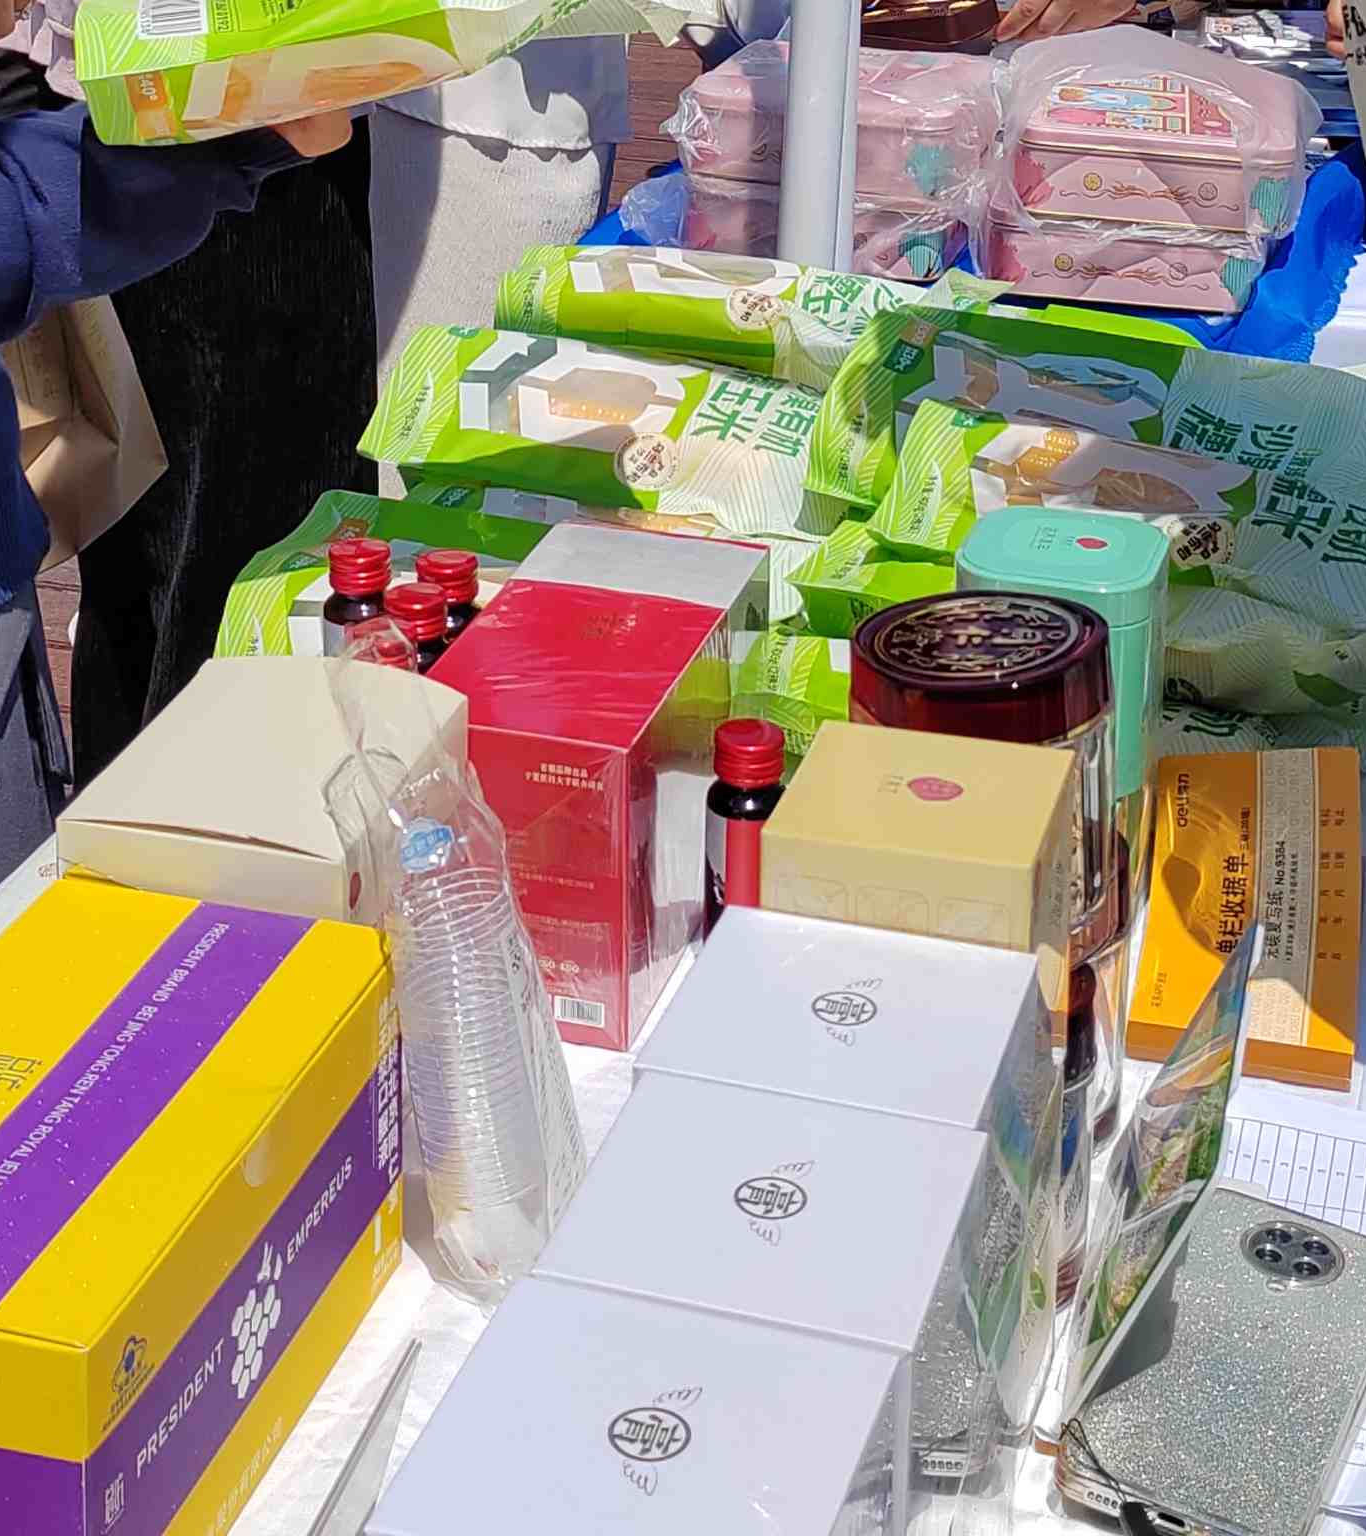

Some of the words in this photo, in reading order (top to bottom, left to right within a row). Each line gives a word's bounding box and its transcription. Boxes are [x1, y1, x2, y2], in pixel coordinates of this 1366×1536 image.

[181, 922, 230, 972] PRESIDENT
[152, 967, 189, 1003] BRAND
[43, 1090, 81, 1125] TANG
[11, 1121, 54, 1163] ROYAL
[285, 1154, 355, 1266] EMPEREUS
[134, 1337, 227, 1478] PRESIDENT
